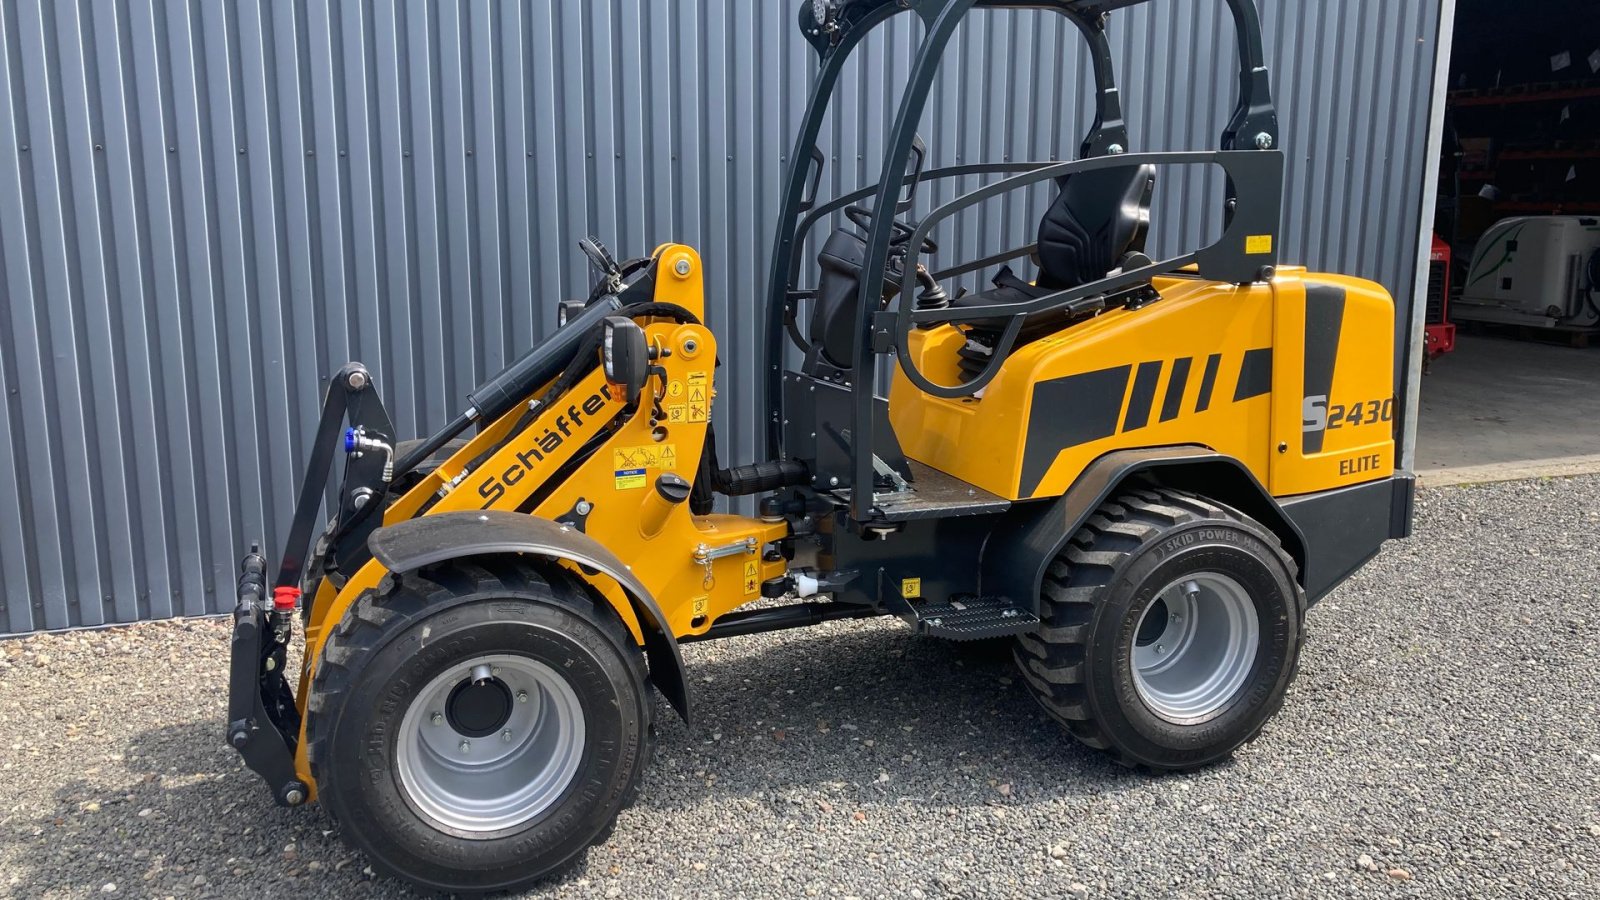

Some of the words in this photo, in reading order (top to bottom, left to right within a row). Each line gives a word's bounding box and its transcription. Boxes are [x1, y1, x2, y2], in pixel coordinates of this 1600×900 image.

[478, 384, 613, 509] Schäffer
[1339, 454, 1380, 476] ELITE
[1166, 533, 1194, 552] SKID
[1198, 530, 1239, 542] POWER
